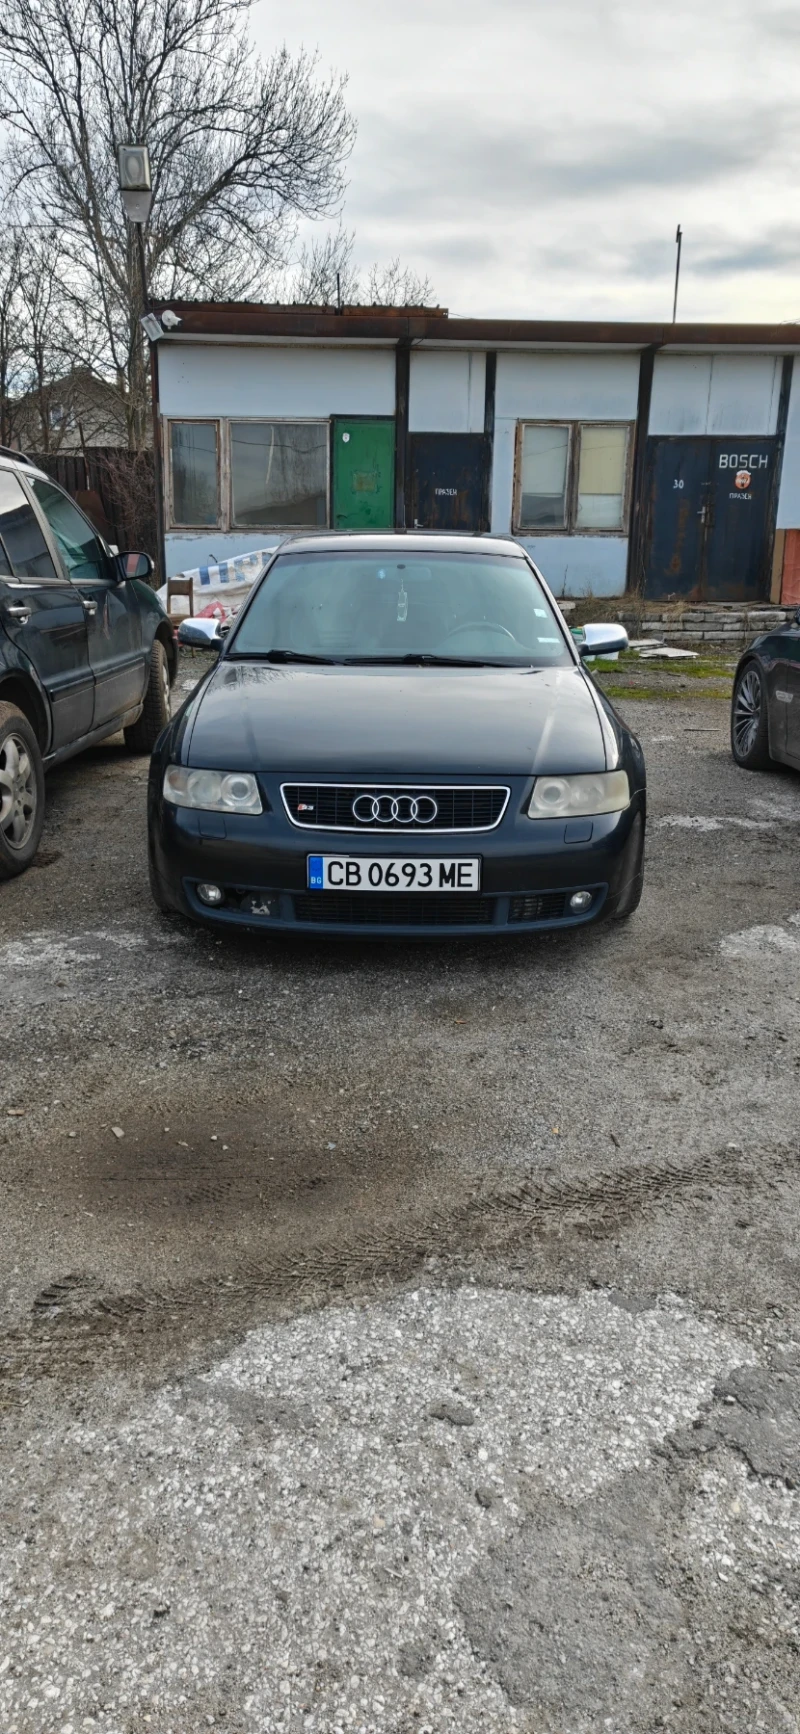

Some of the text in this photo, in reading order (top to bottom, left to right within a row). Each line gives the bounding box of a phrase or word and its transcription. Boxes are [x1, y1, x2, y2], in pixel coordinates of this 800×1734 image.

[719, 454, 769, 468] BOSCH
[673, 479, 684, 489] 30
[327, 861, 473, 888] CB 0693 ME
